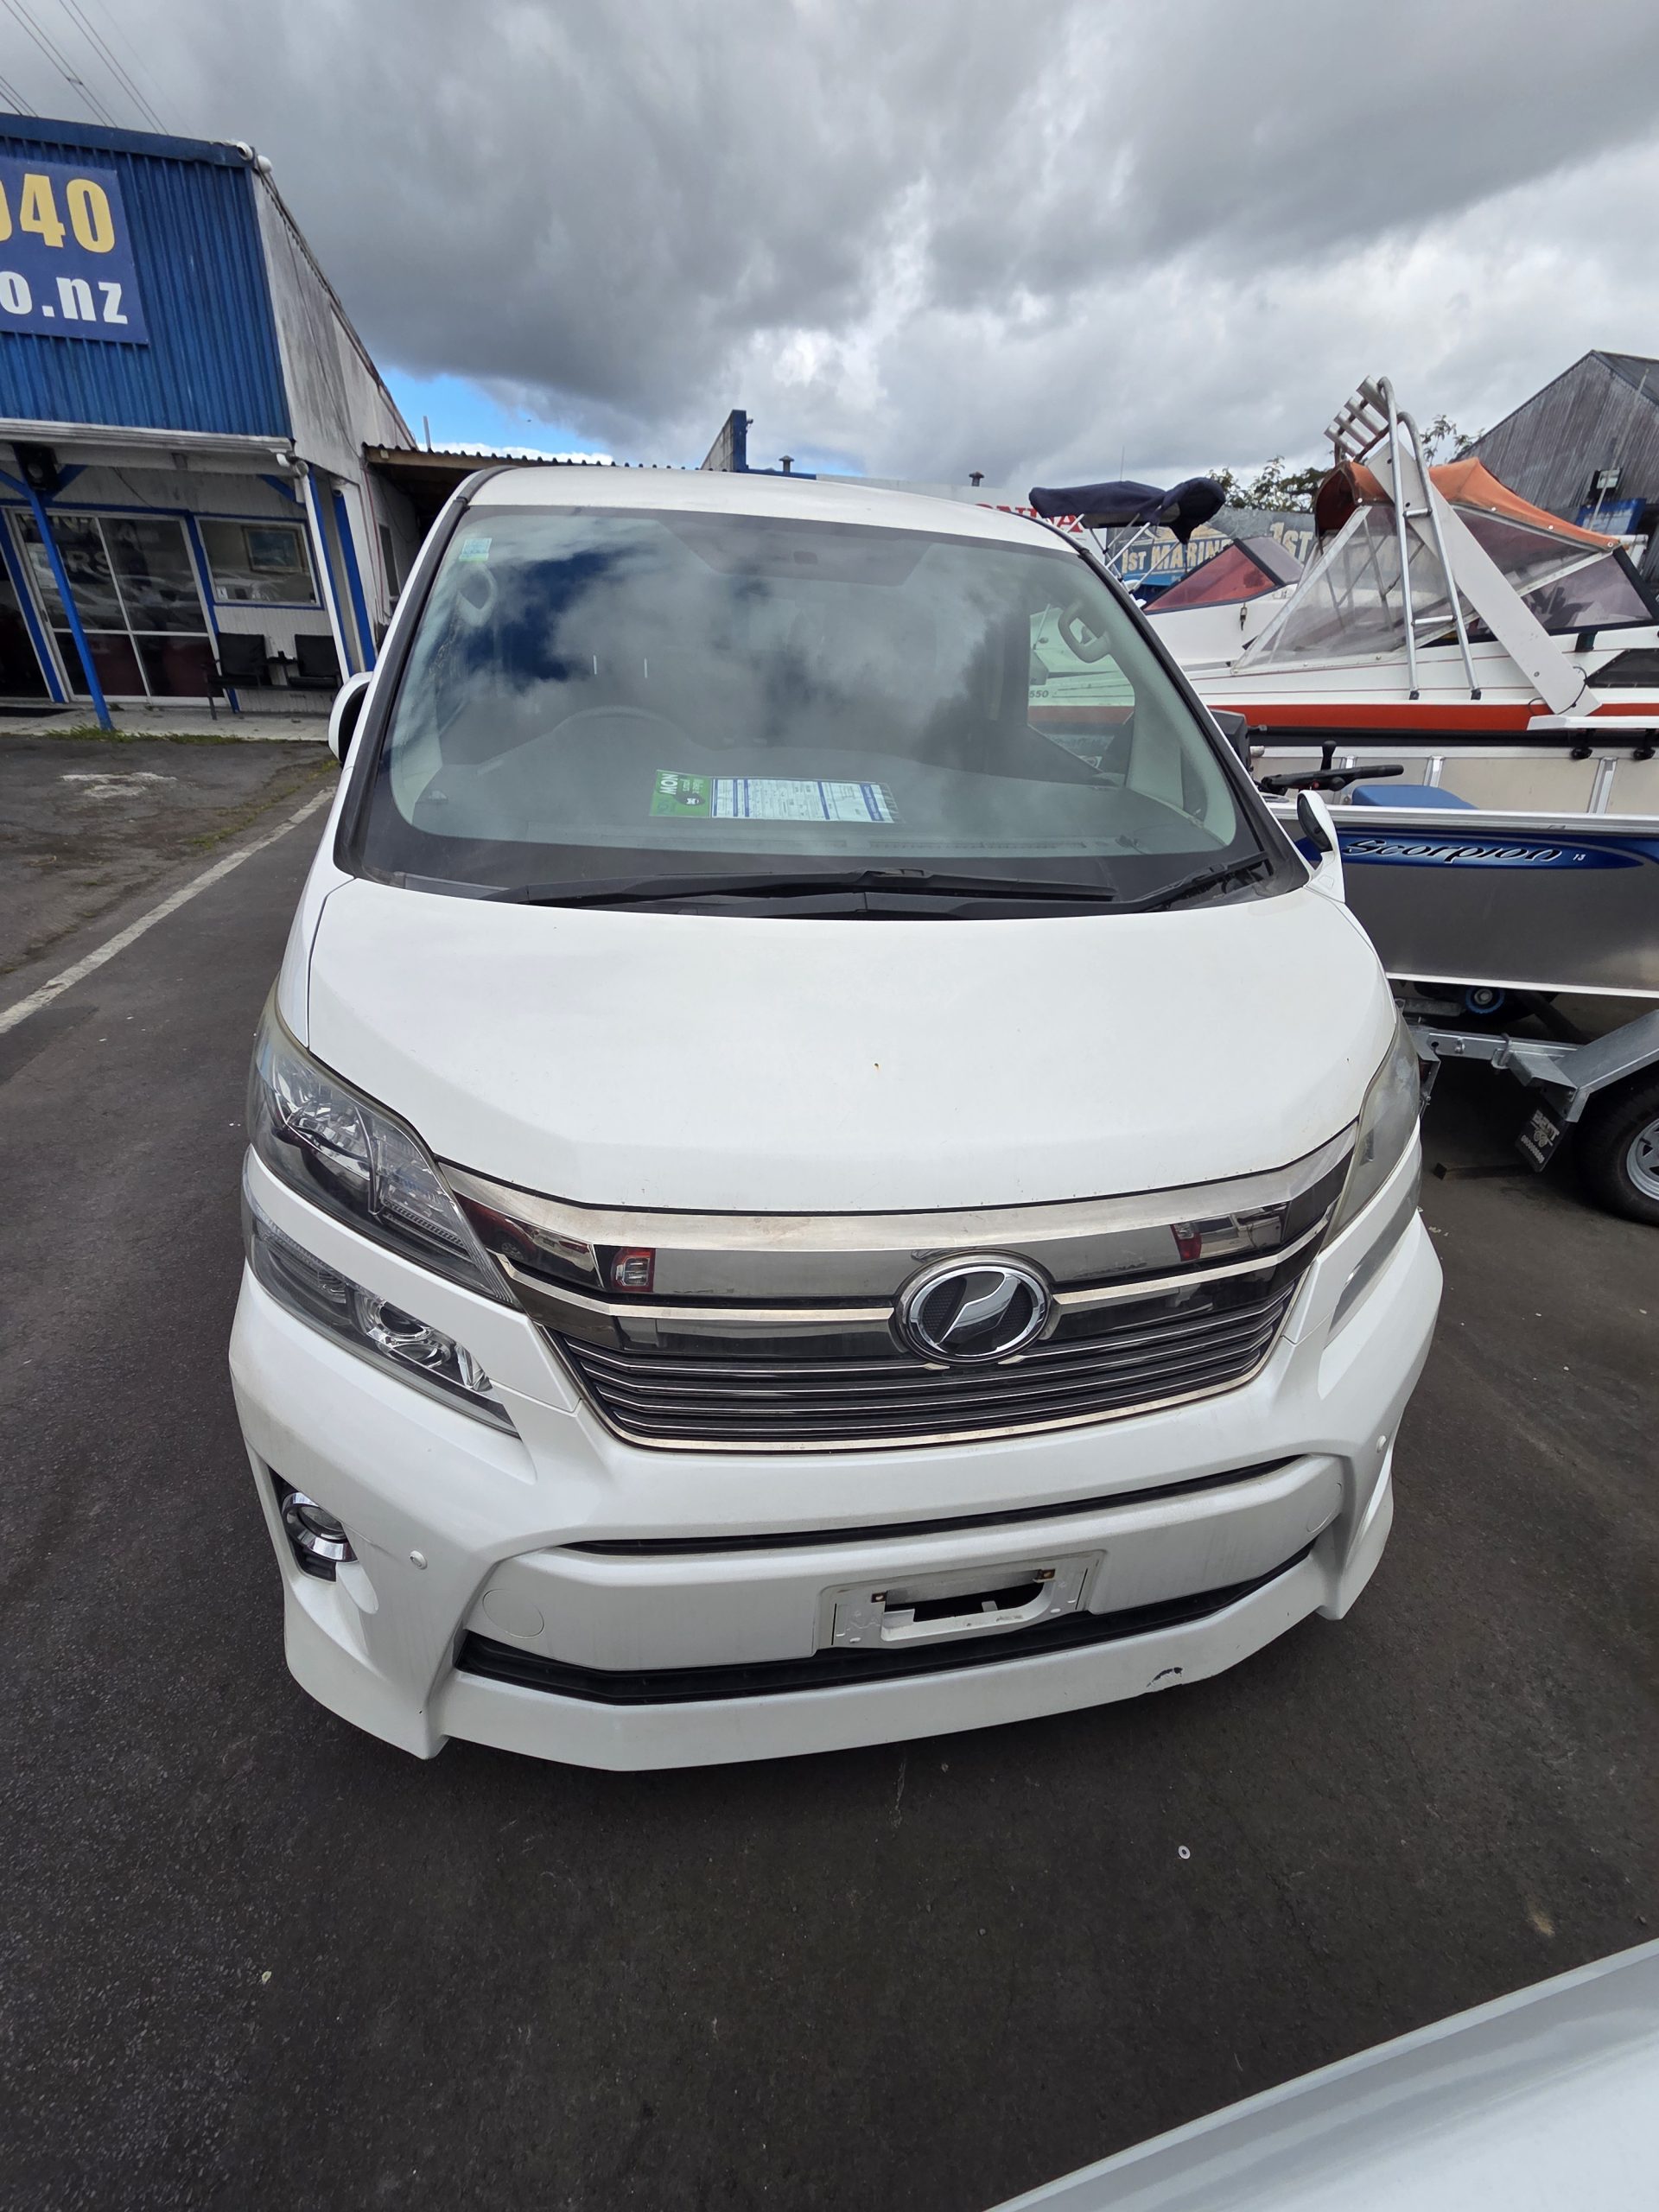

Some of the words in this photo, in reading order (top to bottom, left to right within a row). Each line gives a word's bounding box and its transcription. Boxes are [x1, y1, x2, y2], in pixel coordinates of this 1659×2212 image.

[0, 173, 116, 253] 40
[0, 270, 129, 325] o.nz
[659, 772, 679, 795] NOW
[1343, 838, 1562, 864] Scorpion
